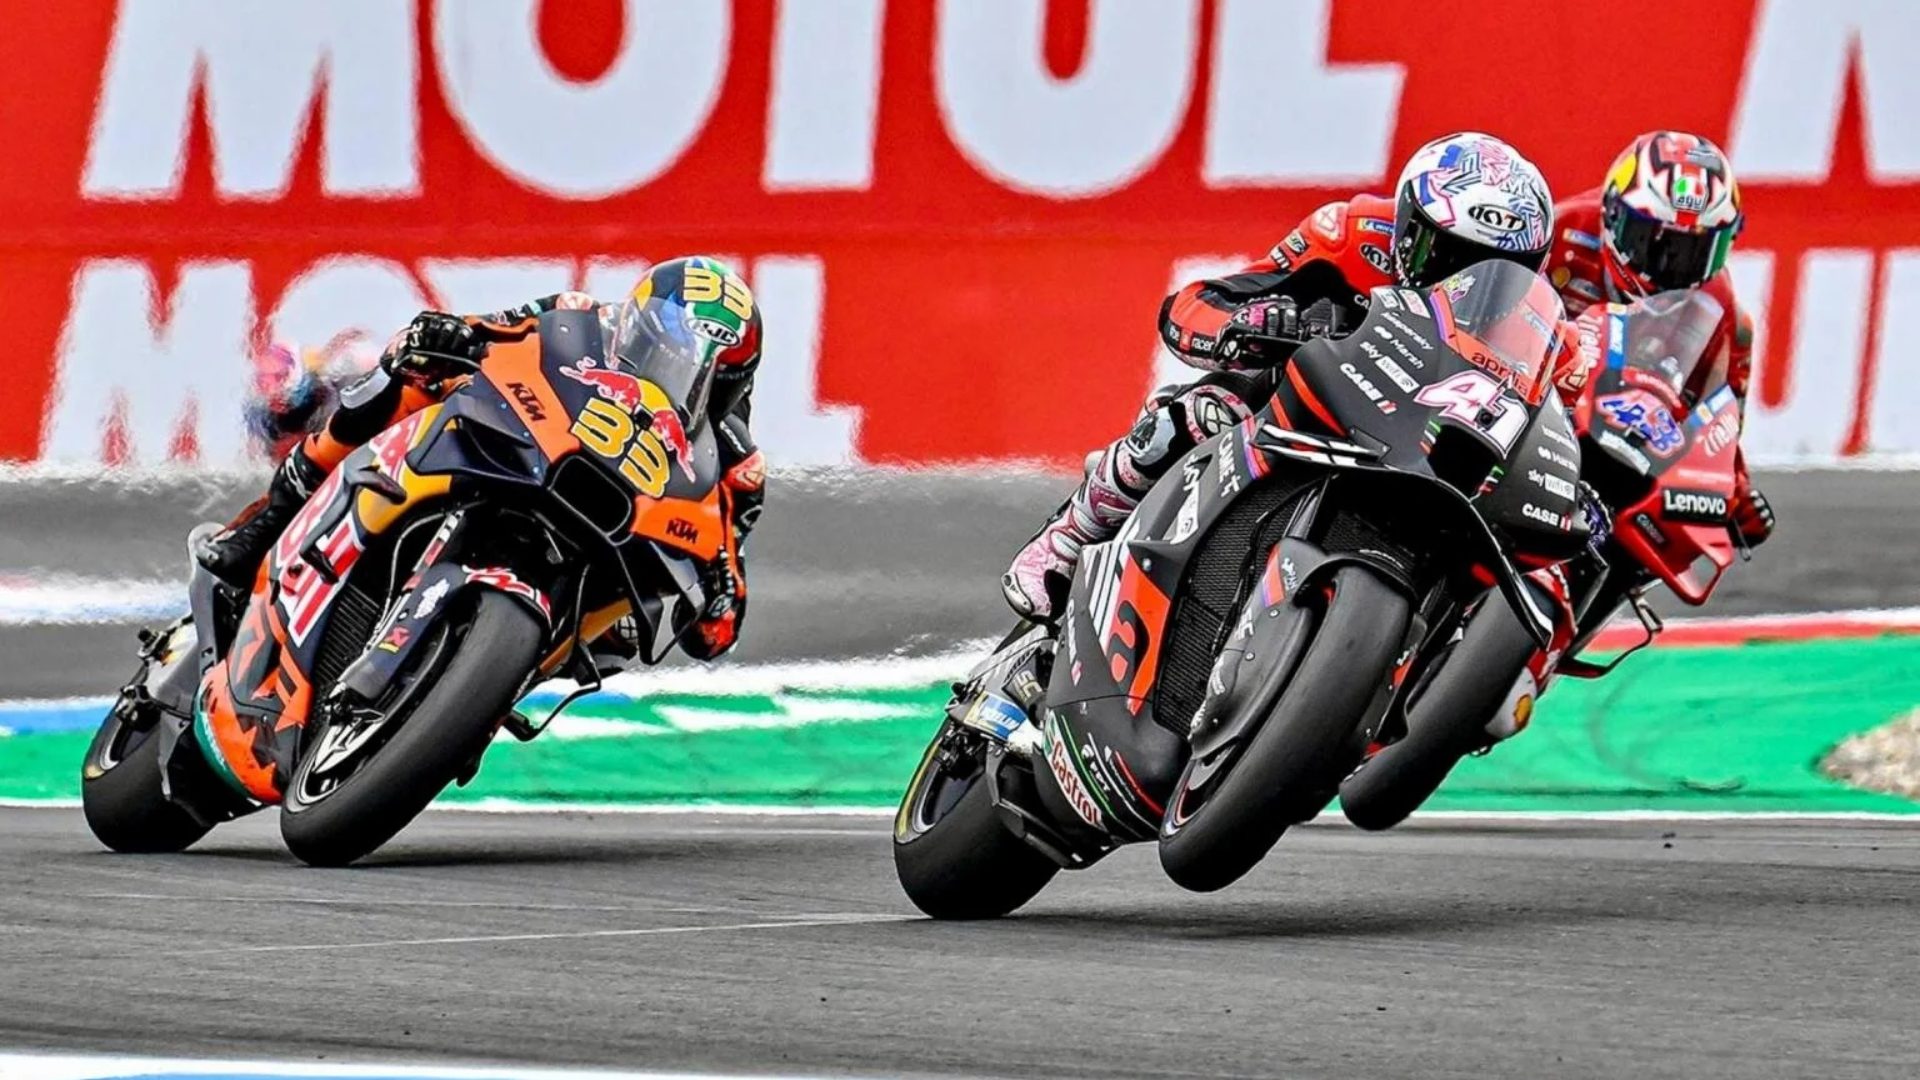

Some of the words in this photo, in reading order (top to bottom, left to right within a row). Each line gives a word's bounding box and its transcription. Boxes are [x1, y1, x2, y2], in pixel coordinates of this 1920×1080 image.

[683, 266, 754, 320] 33
[42, 254, 862, 467] MOL
[1472, 352, 1528, 395] aprlia
[505, 382, 546, 422] KTM
[1340, 363, 1383, 401] CASE
[570, 397, 672, 498] 33
[1522, 502, 1559, 524] CASE
[1664, 489, 1727, 516] Lenovo
[665, 517, 699, 544] KTM
[1051, 740, 1100, 825] Castrol
